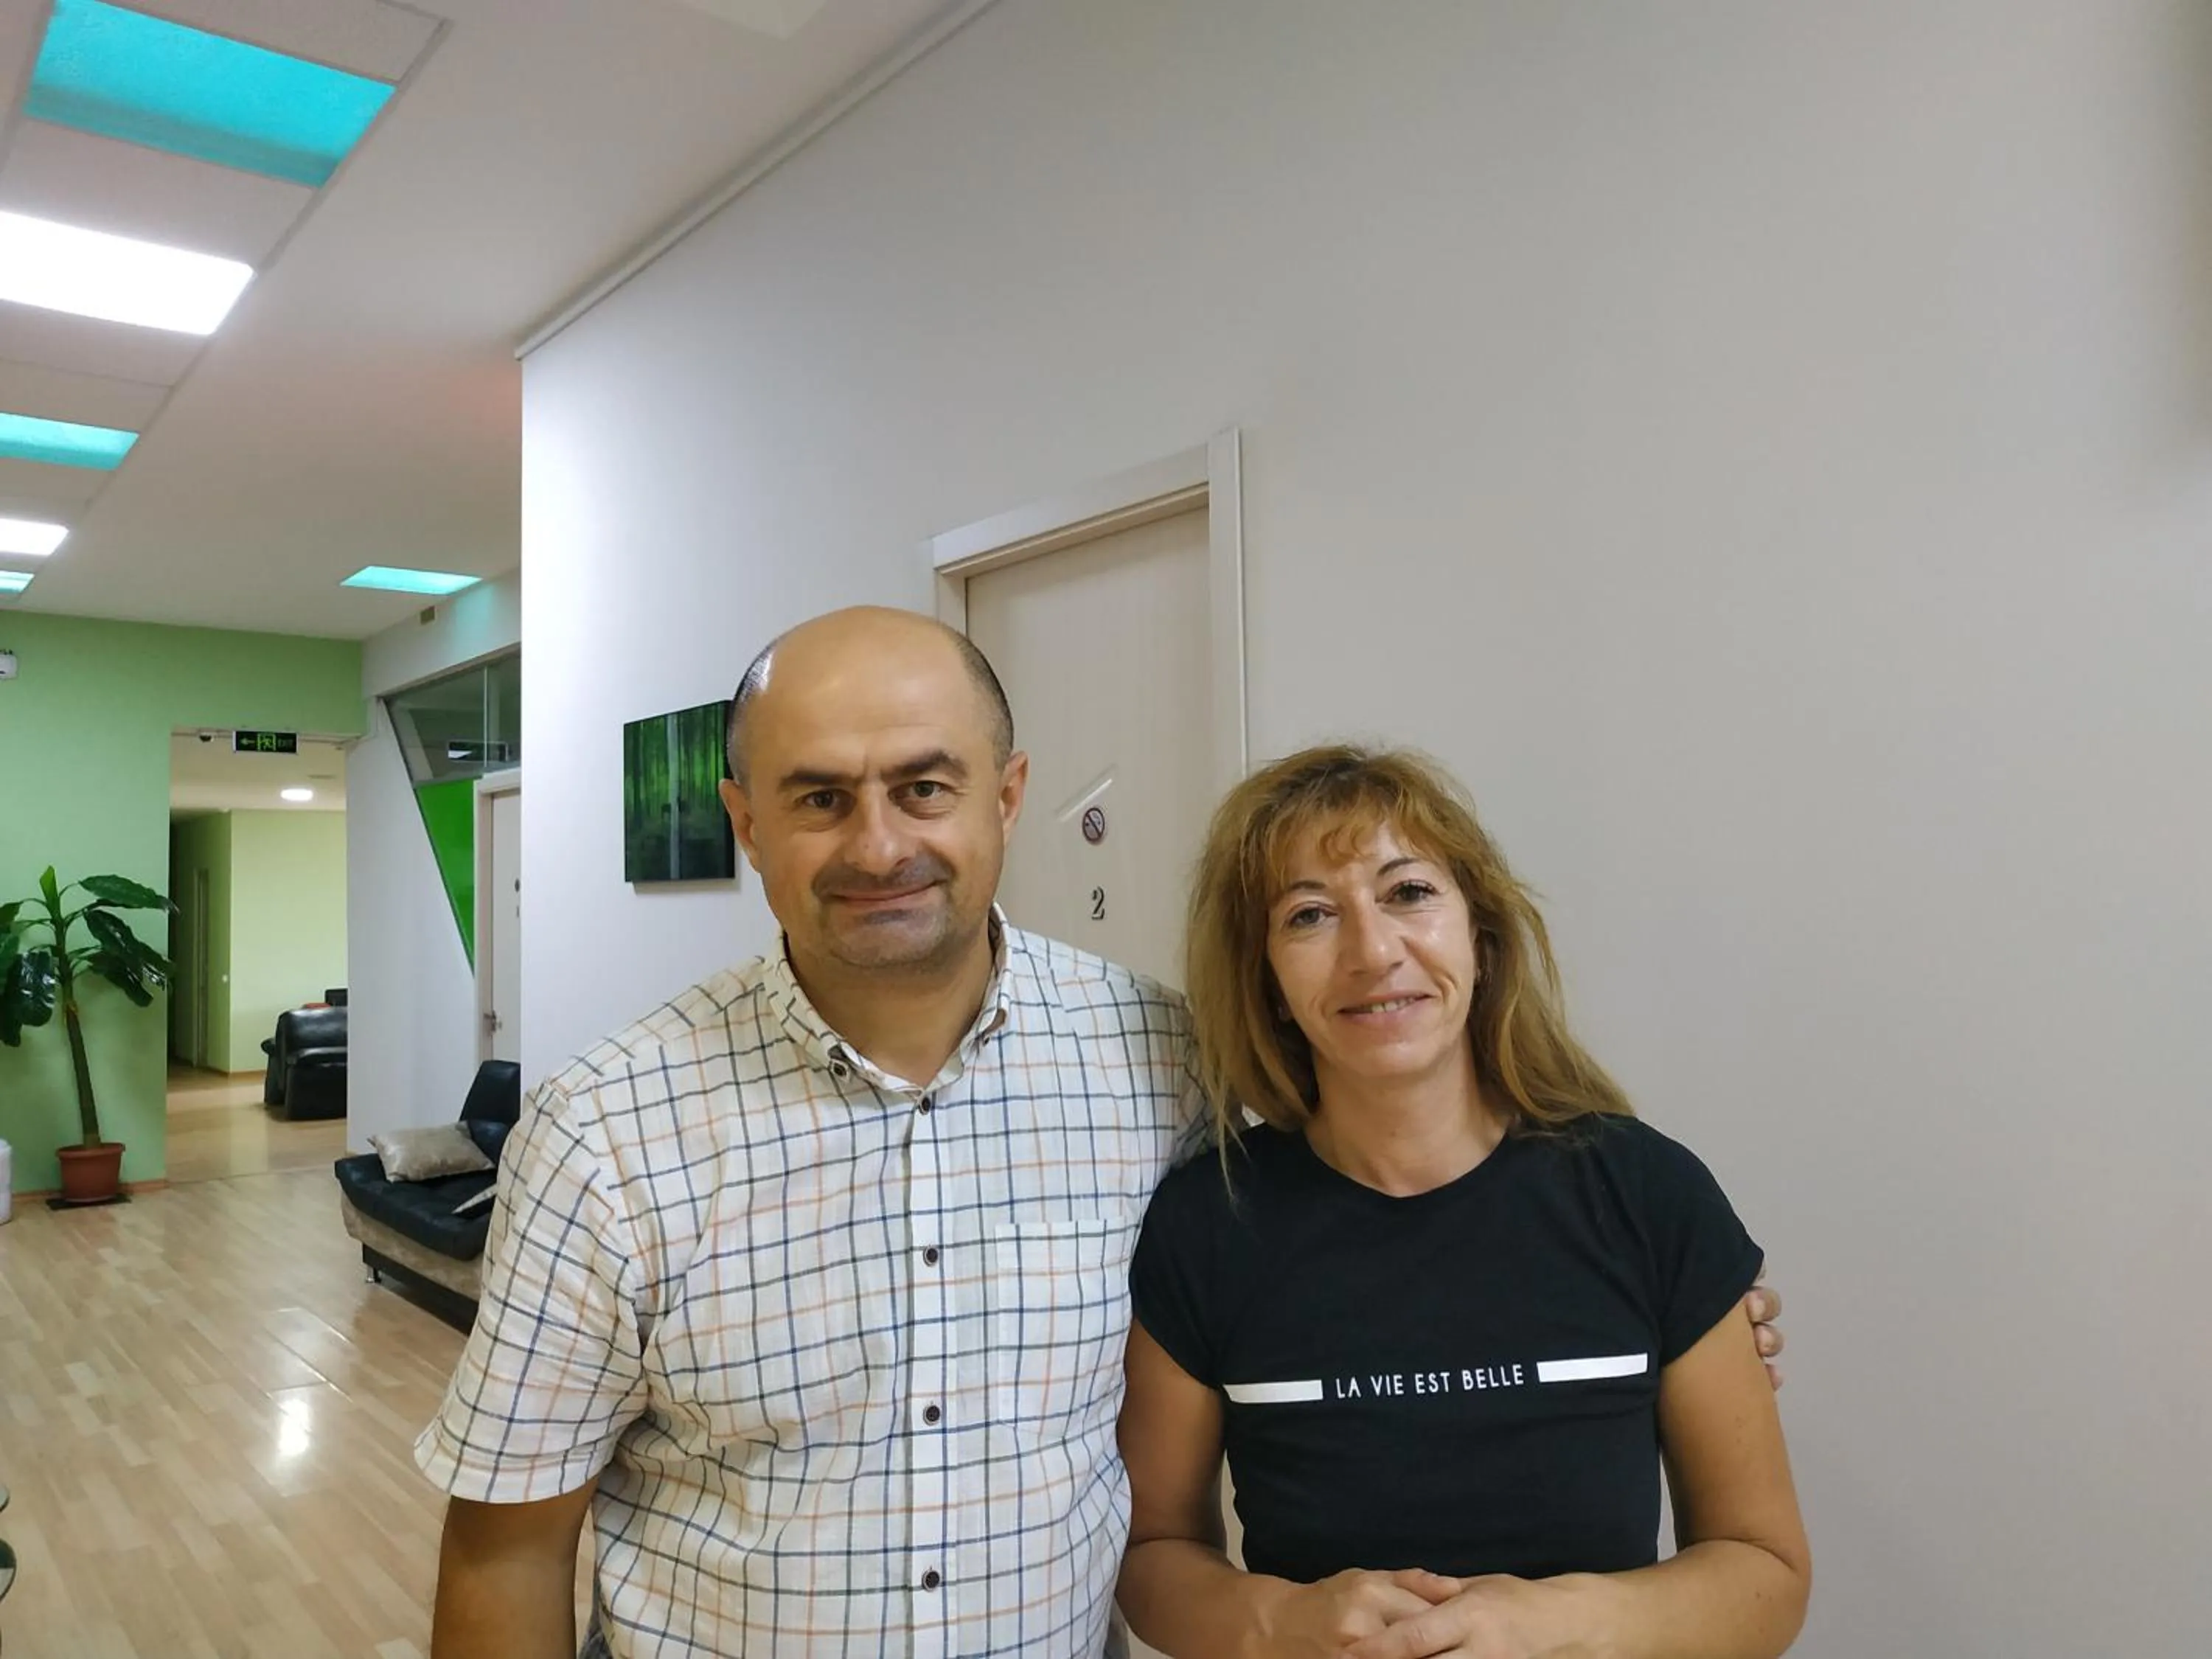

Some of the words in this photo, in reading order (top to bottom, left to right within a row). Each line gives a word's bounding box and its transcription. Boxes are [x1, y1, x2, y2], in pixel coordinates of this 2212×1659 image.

[1091, 886, 1105, 921] 2
[1335, 1377, 1362, 1399] LA
[1370, 1374, 1405, 1397] VIE
[1414, 1371, 1450, 1394] EST
[1461, 1363, 1524, 1391] BELLE
